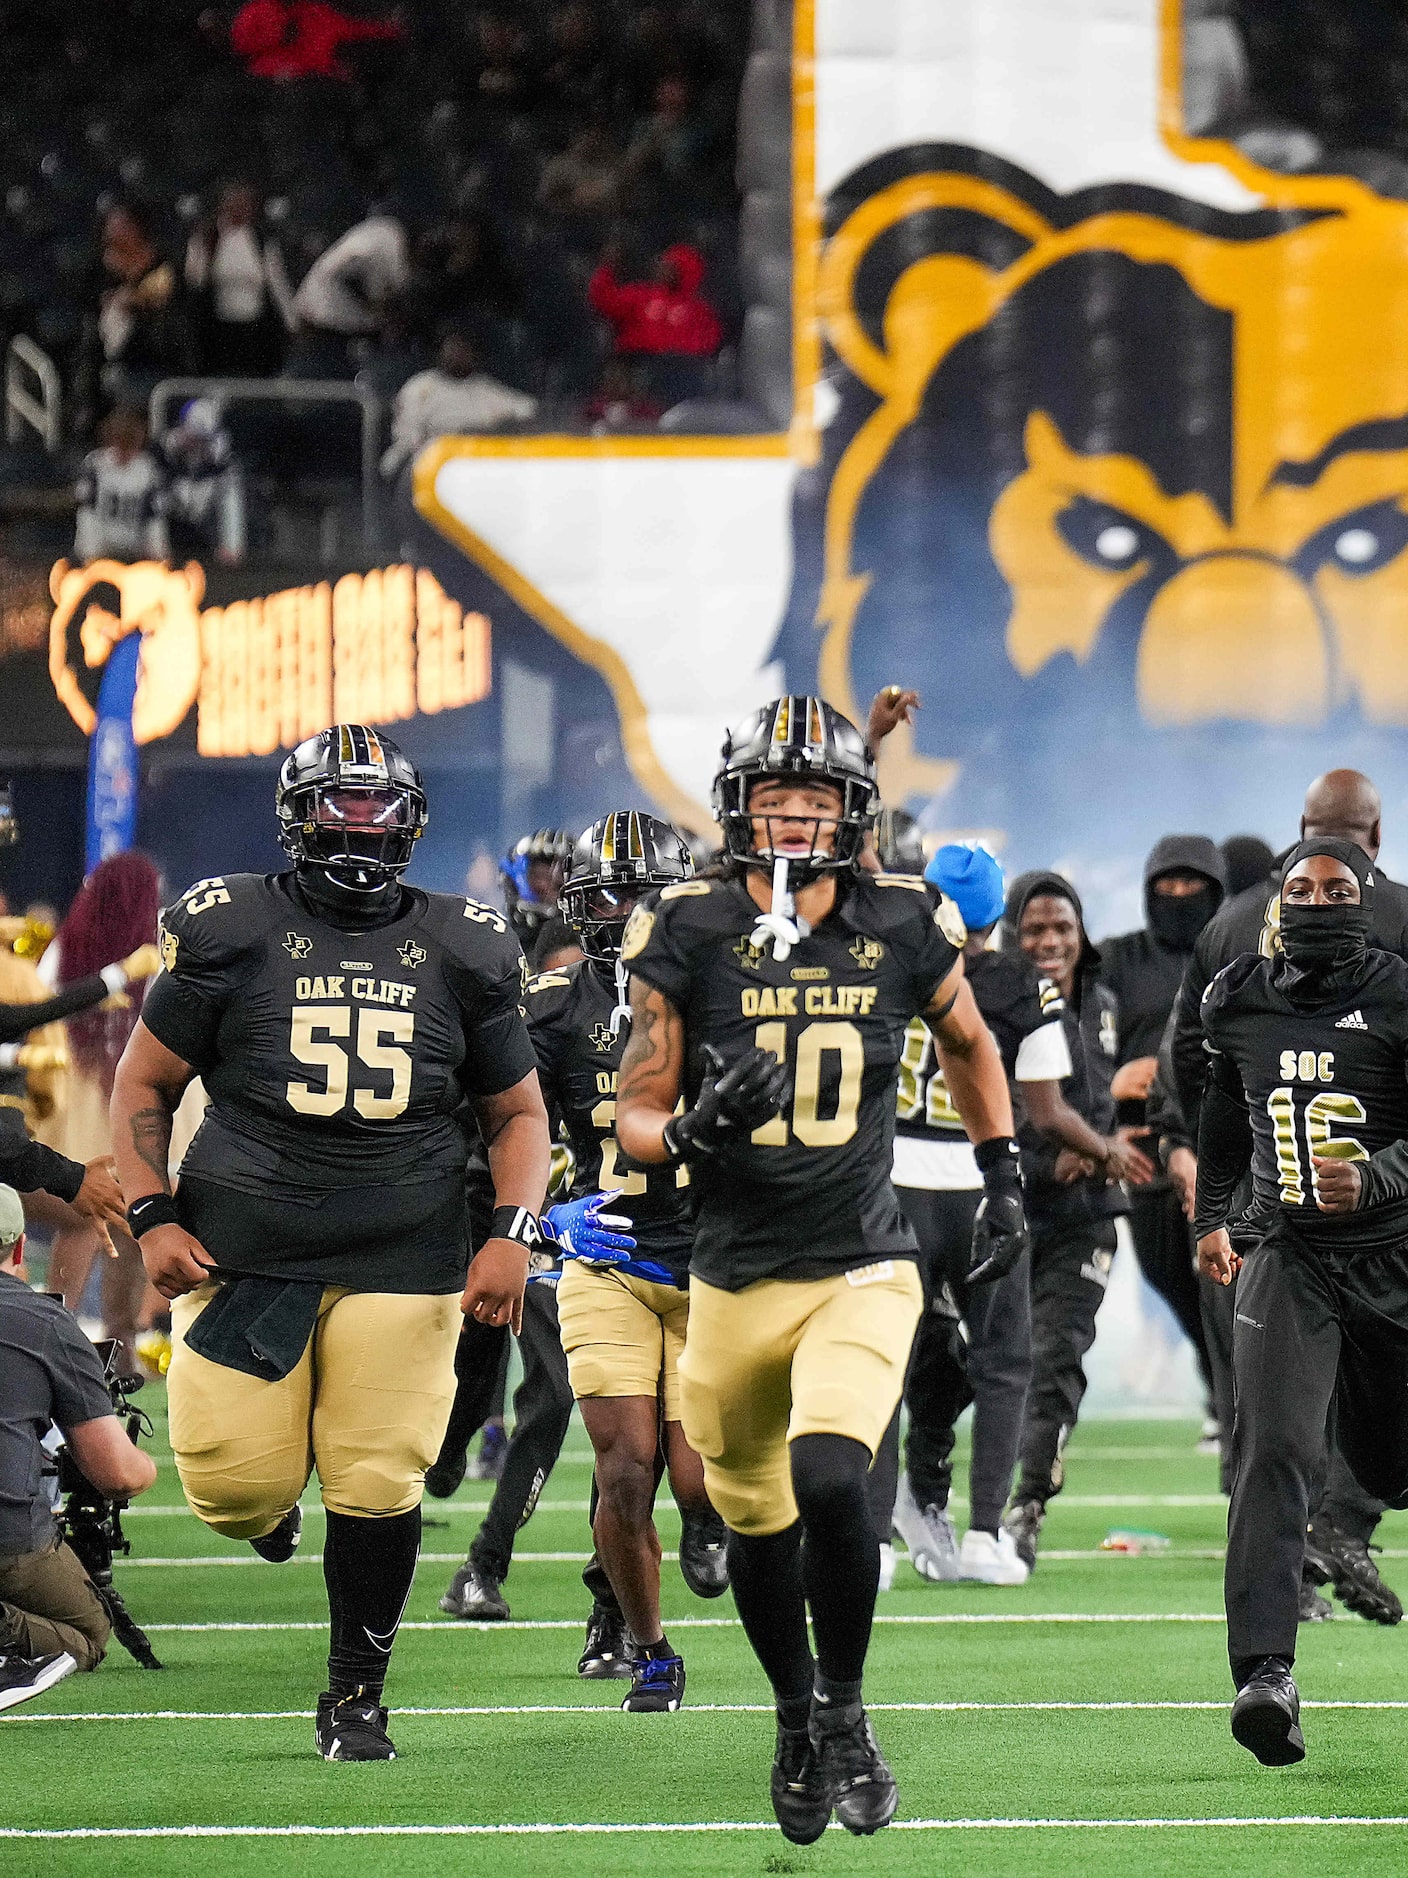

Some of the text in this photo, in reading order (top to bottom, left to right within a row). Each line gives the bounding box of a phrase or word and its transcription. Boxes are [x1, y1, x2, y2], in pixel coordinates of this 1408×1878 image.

[295, 938, 306, 949] 21
[410, 948, 423, 959] 22
[296, 976, 417, 1006] OAK CLIFF
[741, 985, 878, 1017] OAK CLIFF
[601, 1031, 611, 1041] 21
[1334, 1020, 1369, 1031] adidas
[286, 1006, 415, 1120] 55
[1279, 1050, 1335, 1082] SOC
[751, 1021, 865, 1147] 10
